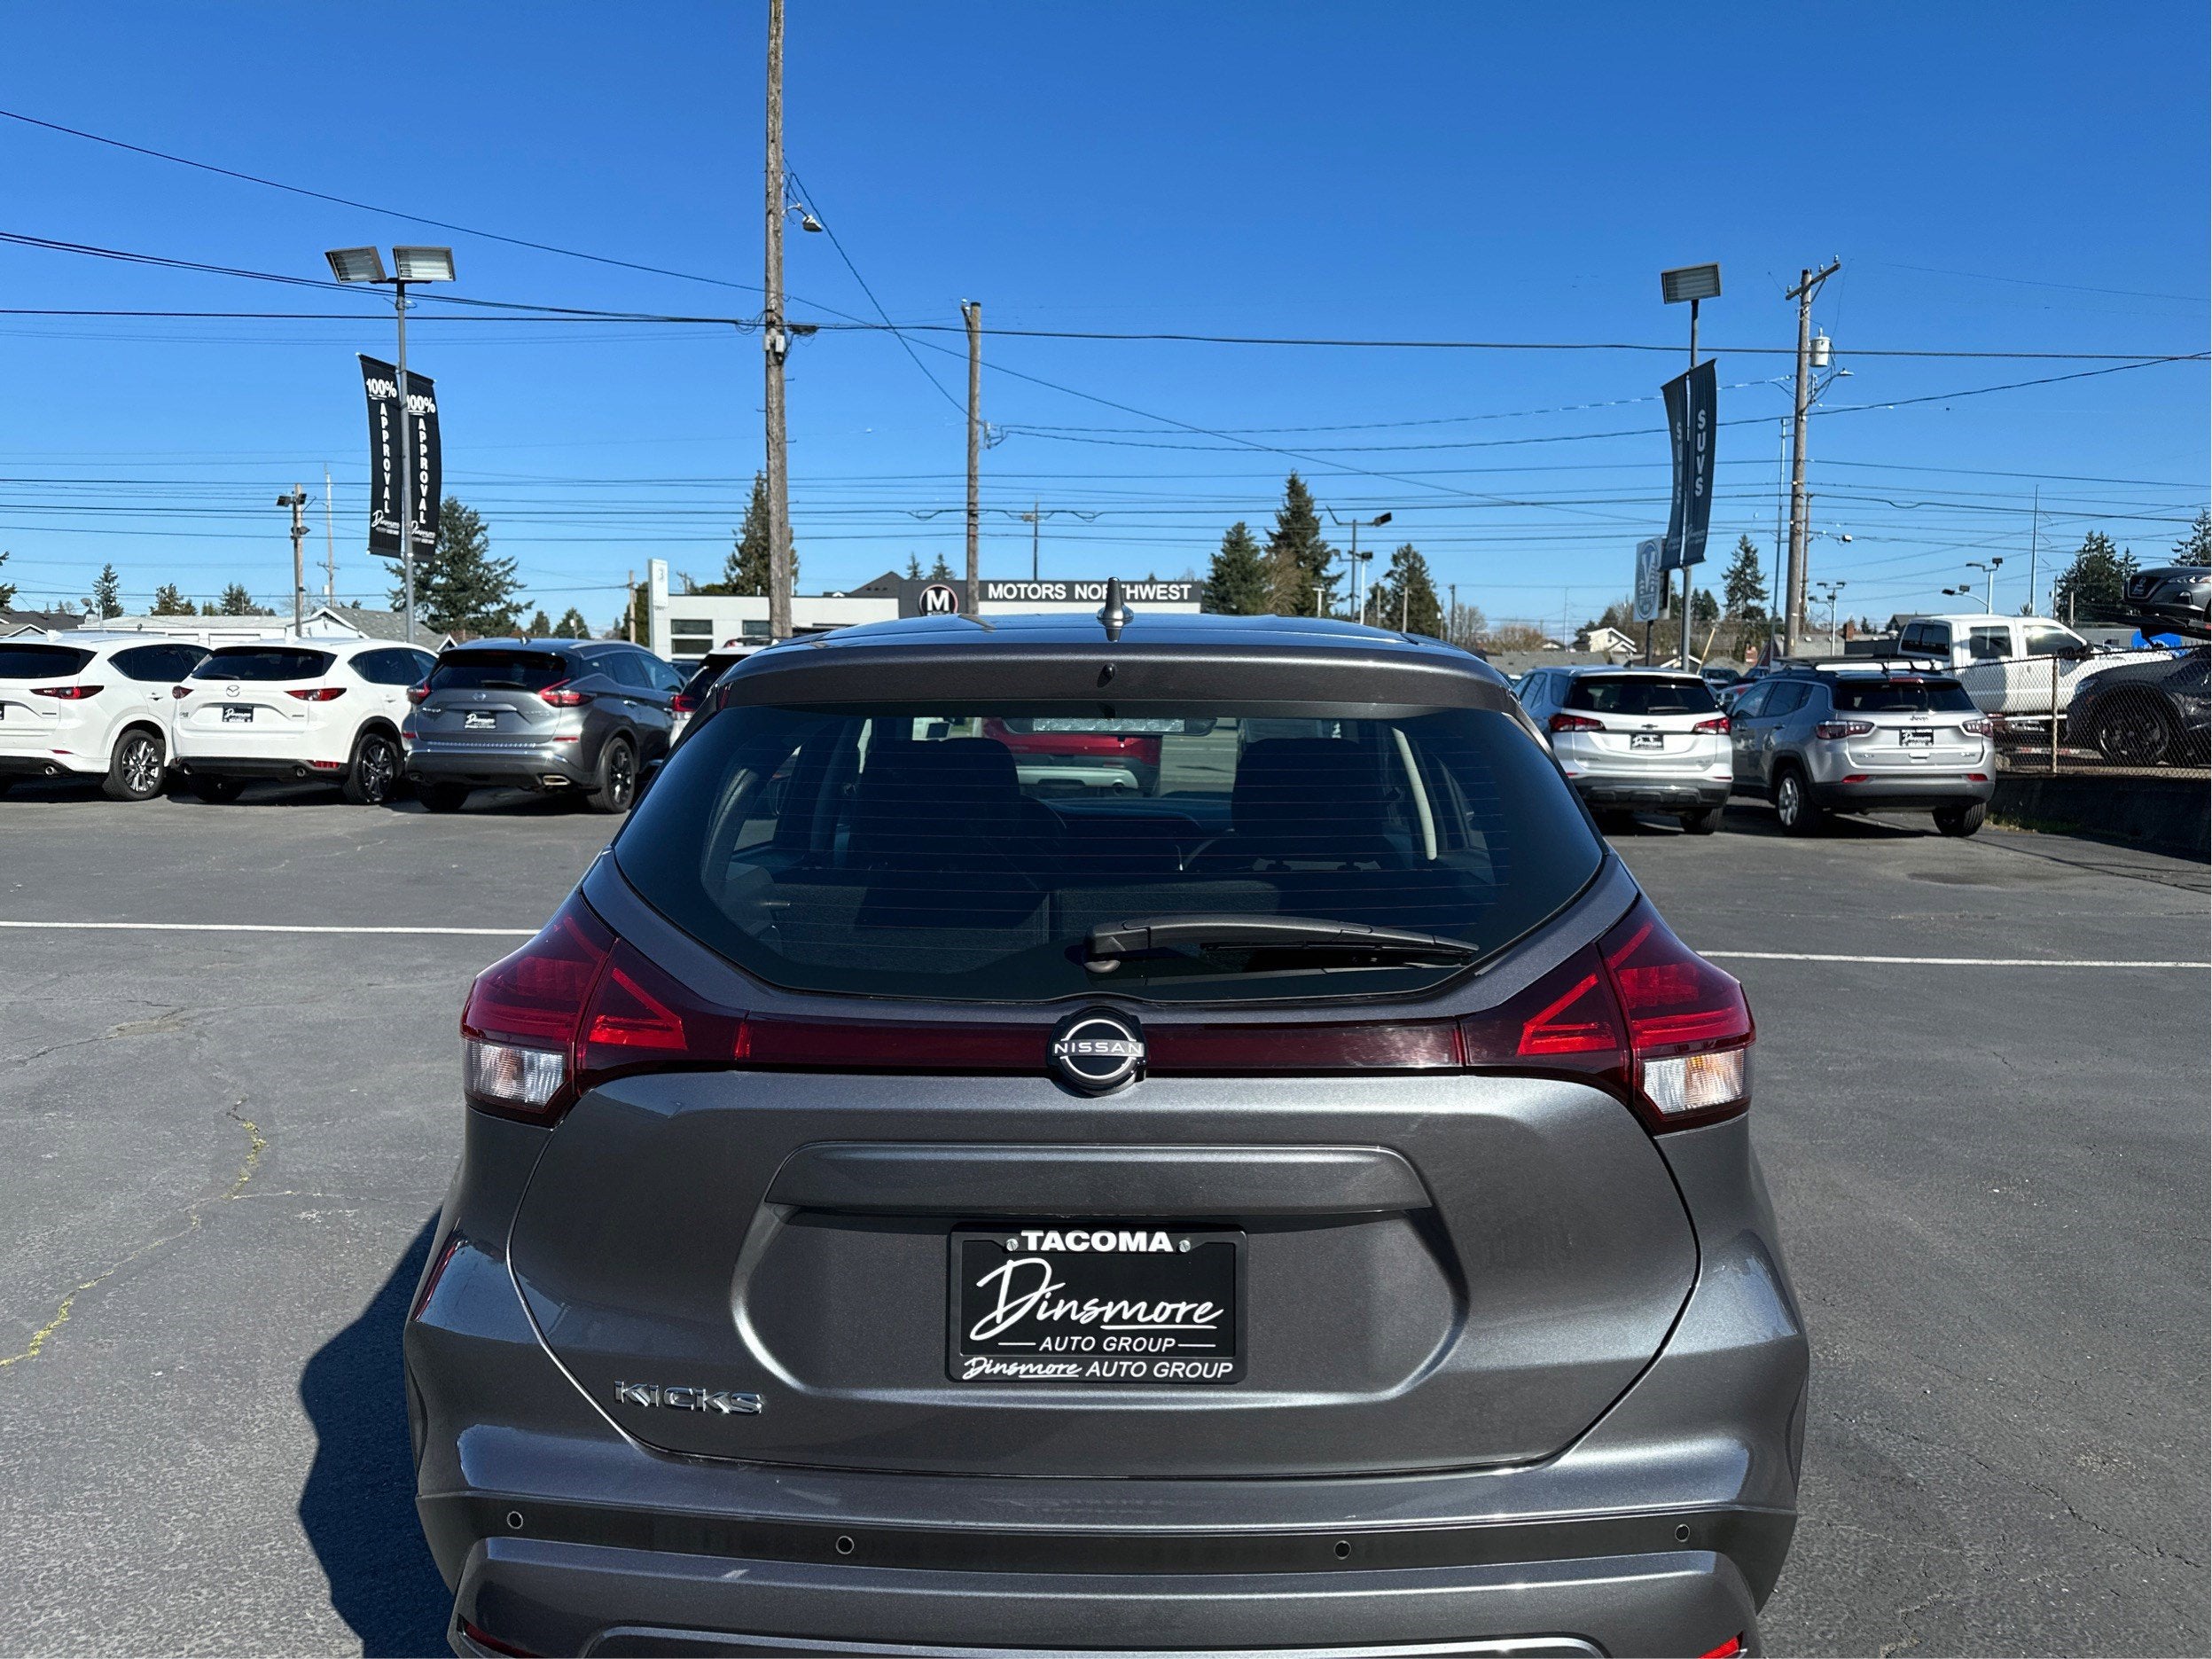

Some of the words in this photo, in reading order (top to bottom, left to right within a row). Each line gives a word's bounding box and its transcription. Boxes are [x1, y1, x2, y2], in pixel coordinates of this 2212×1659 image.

[366, 378, 397, 398] 100%
[407, 395, 435, 413] 100%
[379, 402, 390, 513] APPROVAL
[1695, 409, 1707, 497] SUVS
[418, 418, 428, 524] APPROVAL
[926, 590, 950, 611] M
[989, 583, 1067, 600] MOTORS
[1054, 1042, 1142, 1054] NISSAN
[1020, 1231, 1174, 1252] TACOMA
[970, 1257, 1224, 1341] Dinsmore
[1039, 1336, 1096, 1352] AUTO
[1103, 1336, 1176, 1352] GROUP
[962, 1357, 1083, 1380] Dinsmore
[1085, 1361, 1147, 1378] AUTO
[1153, 1362, 1233, 1378] GROUP
[614, 1381, 764, 1414] KICKS
